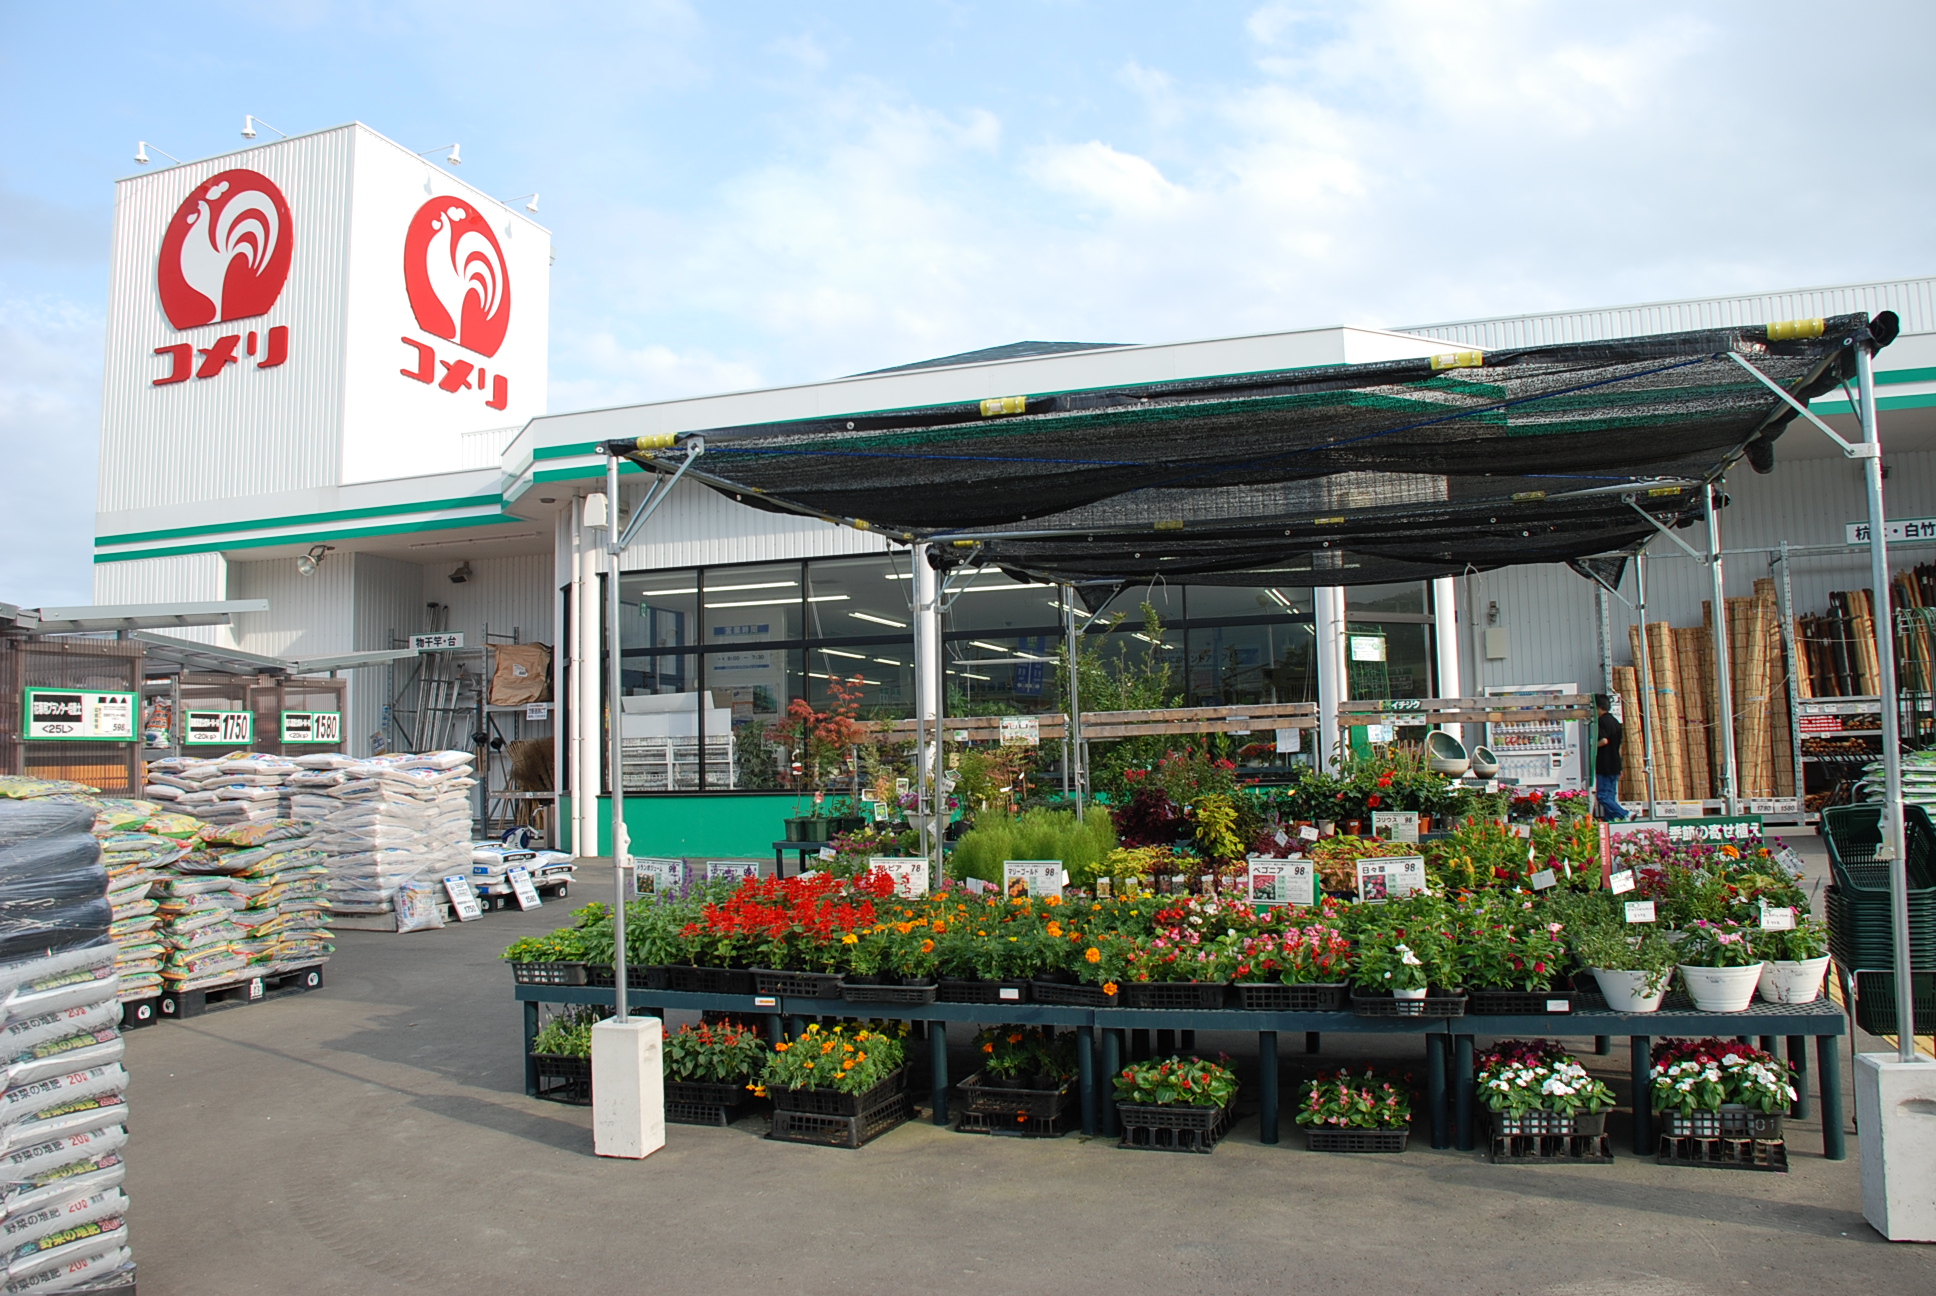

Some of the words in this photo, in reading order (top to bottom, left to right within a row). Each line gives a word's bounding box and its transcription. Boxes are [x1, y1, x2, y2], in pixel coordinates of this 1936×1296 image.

[152, 325, 289, 386] コメリ
[400, 336, 508, 411] コメリ
[1855, 521, 1936, 541] 杭・白竹
[415, 635, 456, 648] 物干竿・台
[1391, 700, 1421, 710] イチジク
[42, 724, 74, 734] <25L>
[223, 714, 248, 740] 1750
[315, 715, 337, 739] 1580
[1669, 822, 1762, 842] 季節の寄せ植え
[911, 864, 922, 873] 78
[1008, 867, 1039, 876] マリーゴールド
[1045, 867, 1056, 877] 98
[1253, 866, 1284, 875] ベゴニア
[1294, 866, 1306, 876] 98
[1362, 865, 1386, 875] 日々草
[1404, 862, 1416, 873] 98
[464, 904, 477, 915] 1750
[6, 1078, 62, 1104] 野菜の堆肥
[10, 1140, 65, 1165] 野菜の堆肥
[4, 1206, 61, 1235] 野菜の堆肥
[39, 1223, 101, 1249] 野菜の堆肥
[5, 1268, 62, 1295] 野菜の堆肥
